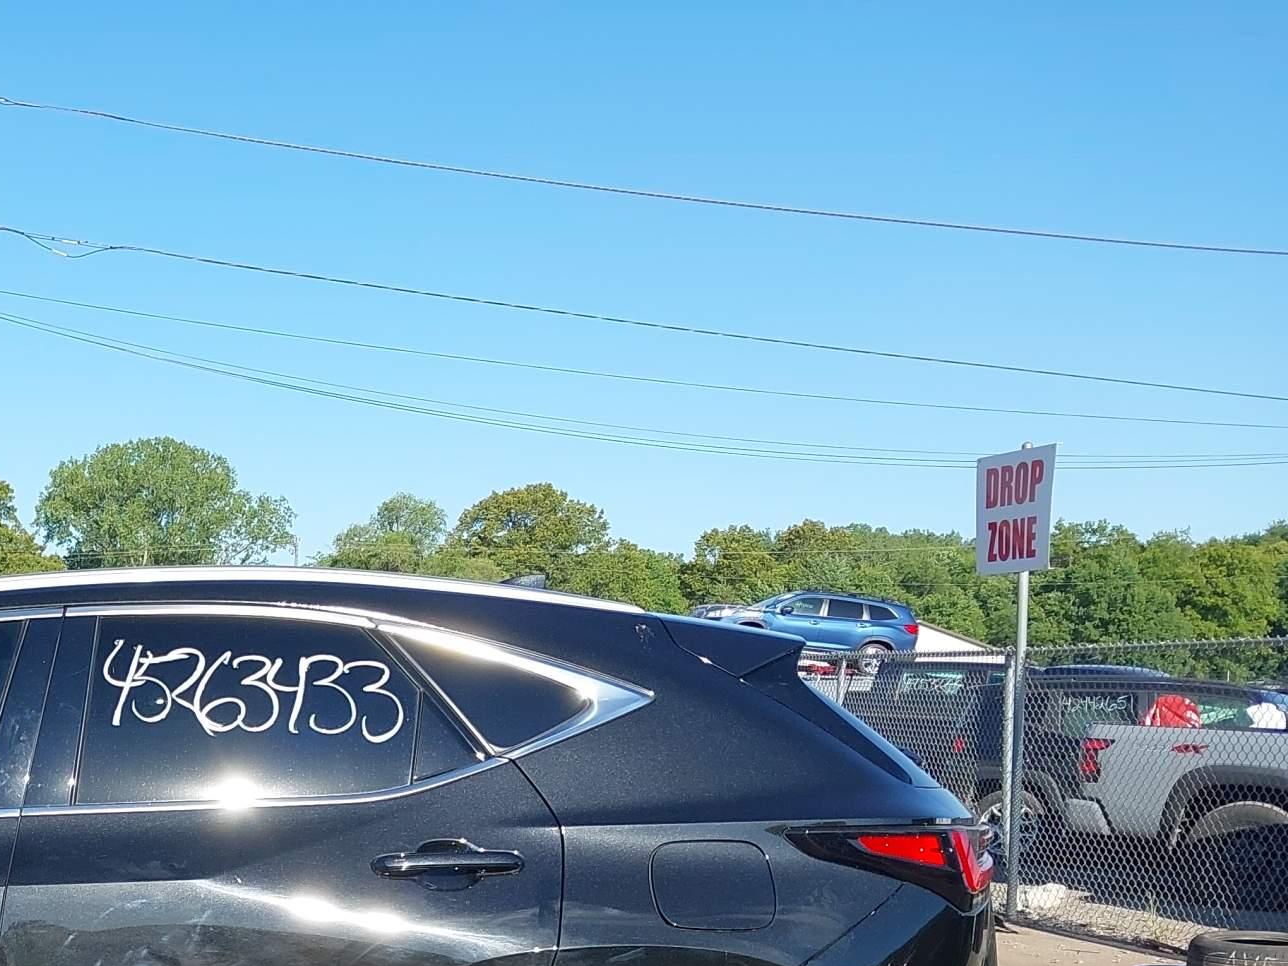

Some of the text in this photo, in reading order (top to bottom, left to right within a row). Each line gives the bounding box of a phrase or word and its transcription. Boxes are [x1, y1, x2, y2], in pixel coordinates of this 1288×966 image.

[985, 459, 1044, 509] DROP
[987, 516, 1037, 562] ZONE
[103, 639, 404, 743] 45263433
